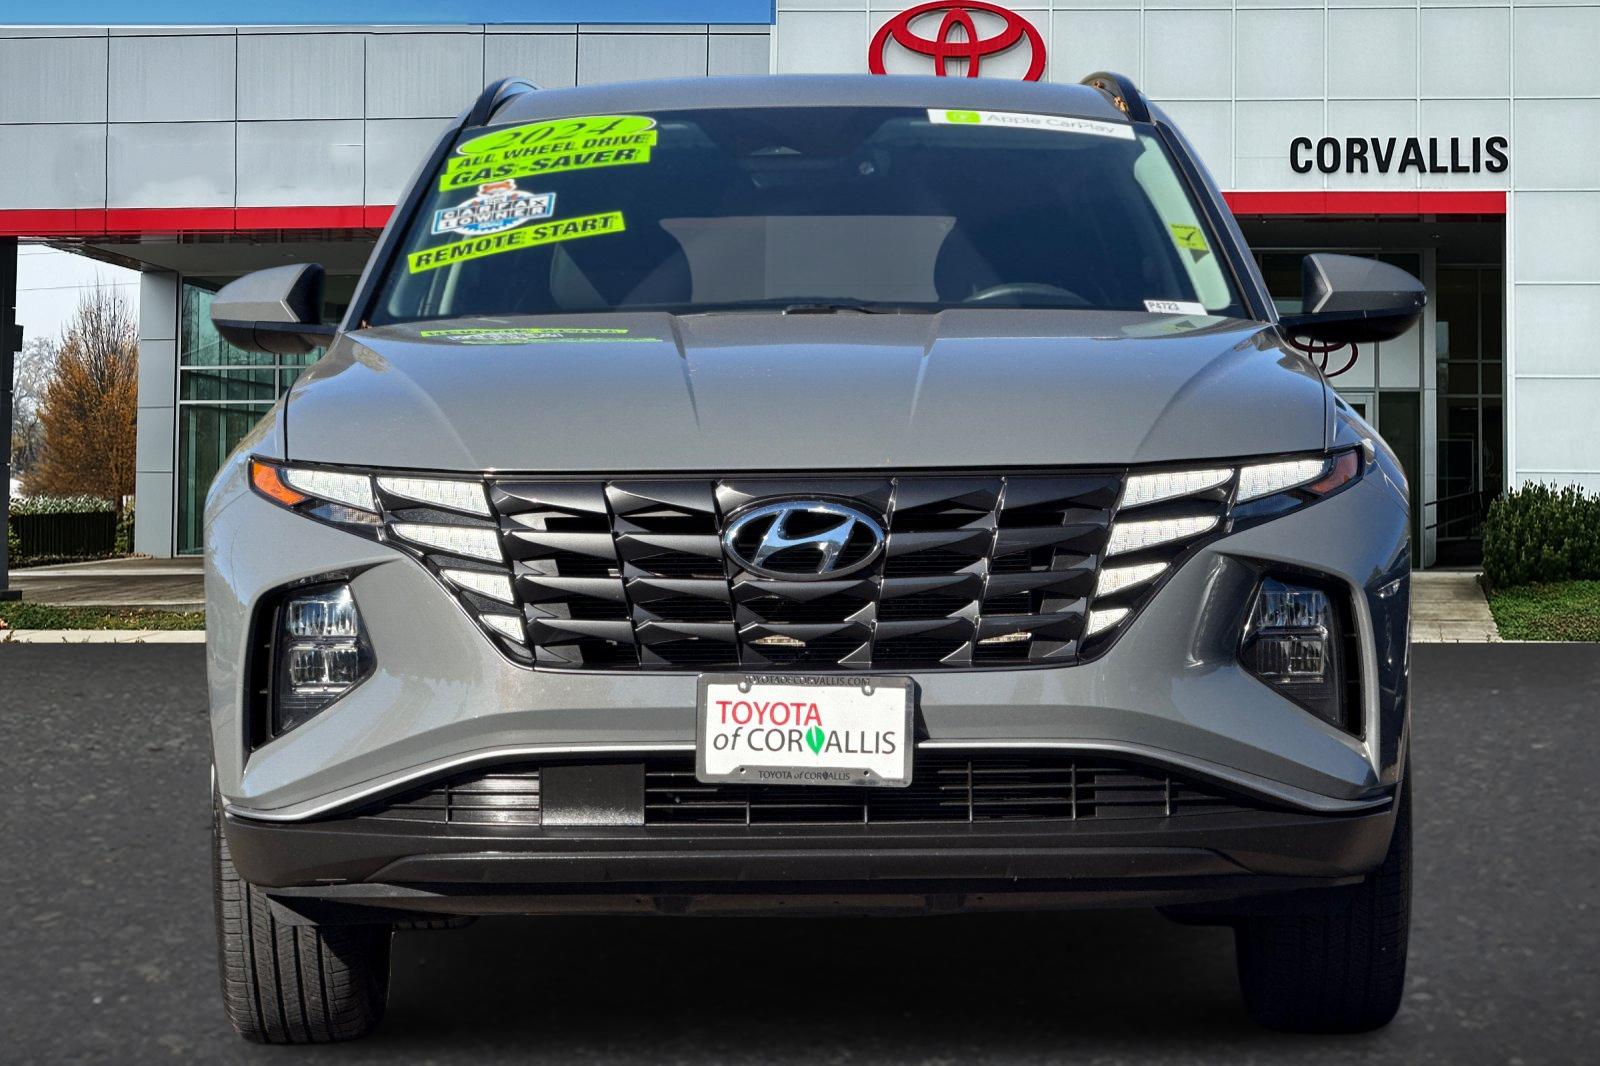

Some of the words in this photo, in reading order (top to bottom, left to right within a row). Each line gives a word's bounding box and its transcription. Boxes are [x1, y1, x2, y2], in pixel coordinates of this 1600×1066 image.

[487, 118, 624, 151] 2024
[986, 112, 1040, 125] Apple
[1046, 117, 1115, 135] CarPlay
[456, 153, 498, 169] ALL
[503, 139, 575, 160] WHEEL
[583, 133, 648, 148] DRIVE
[1289, 136, 1509, 174] CORVALLIS
[415, 231, 527, 267] REMOTE
[532, 215, 614, 241] START
[716, 701, 822, 726] TOYOTA
[713, 727, 743, 751] of
[758, 770, 792, 780] TOYOTA
